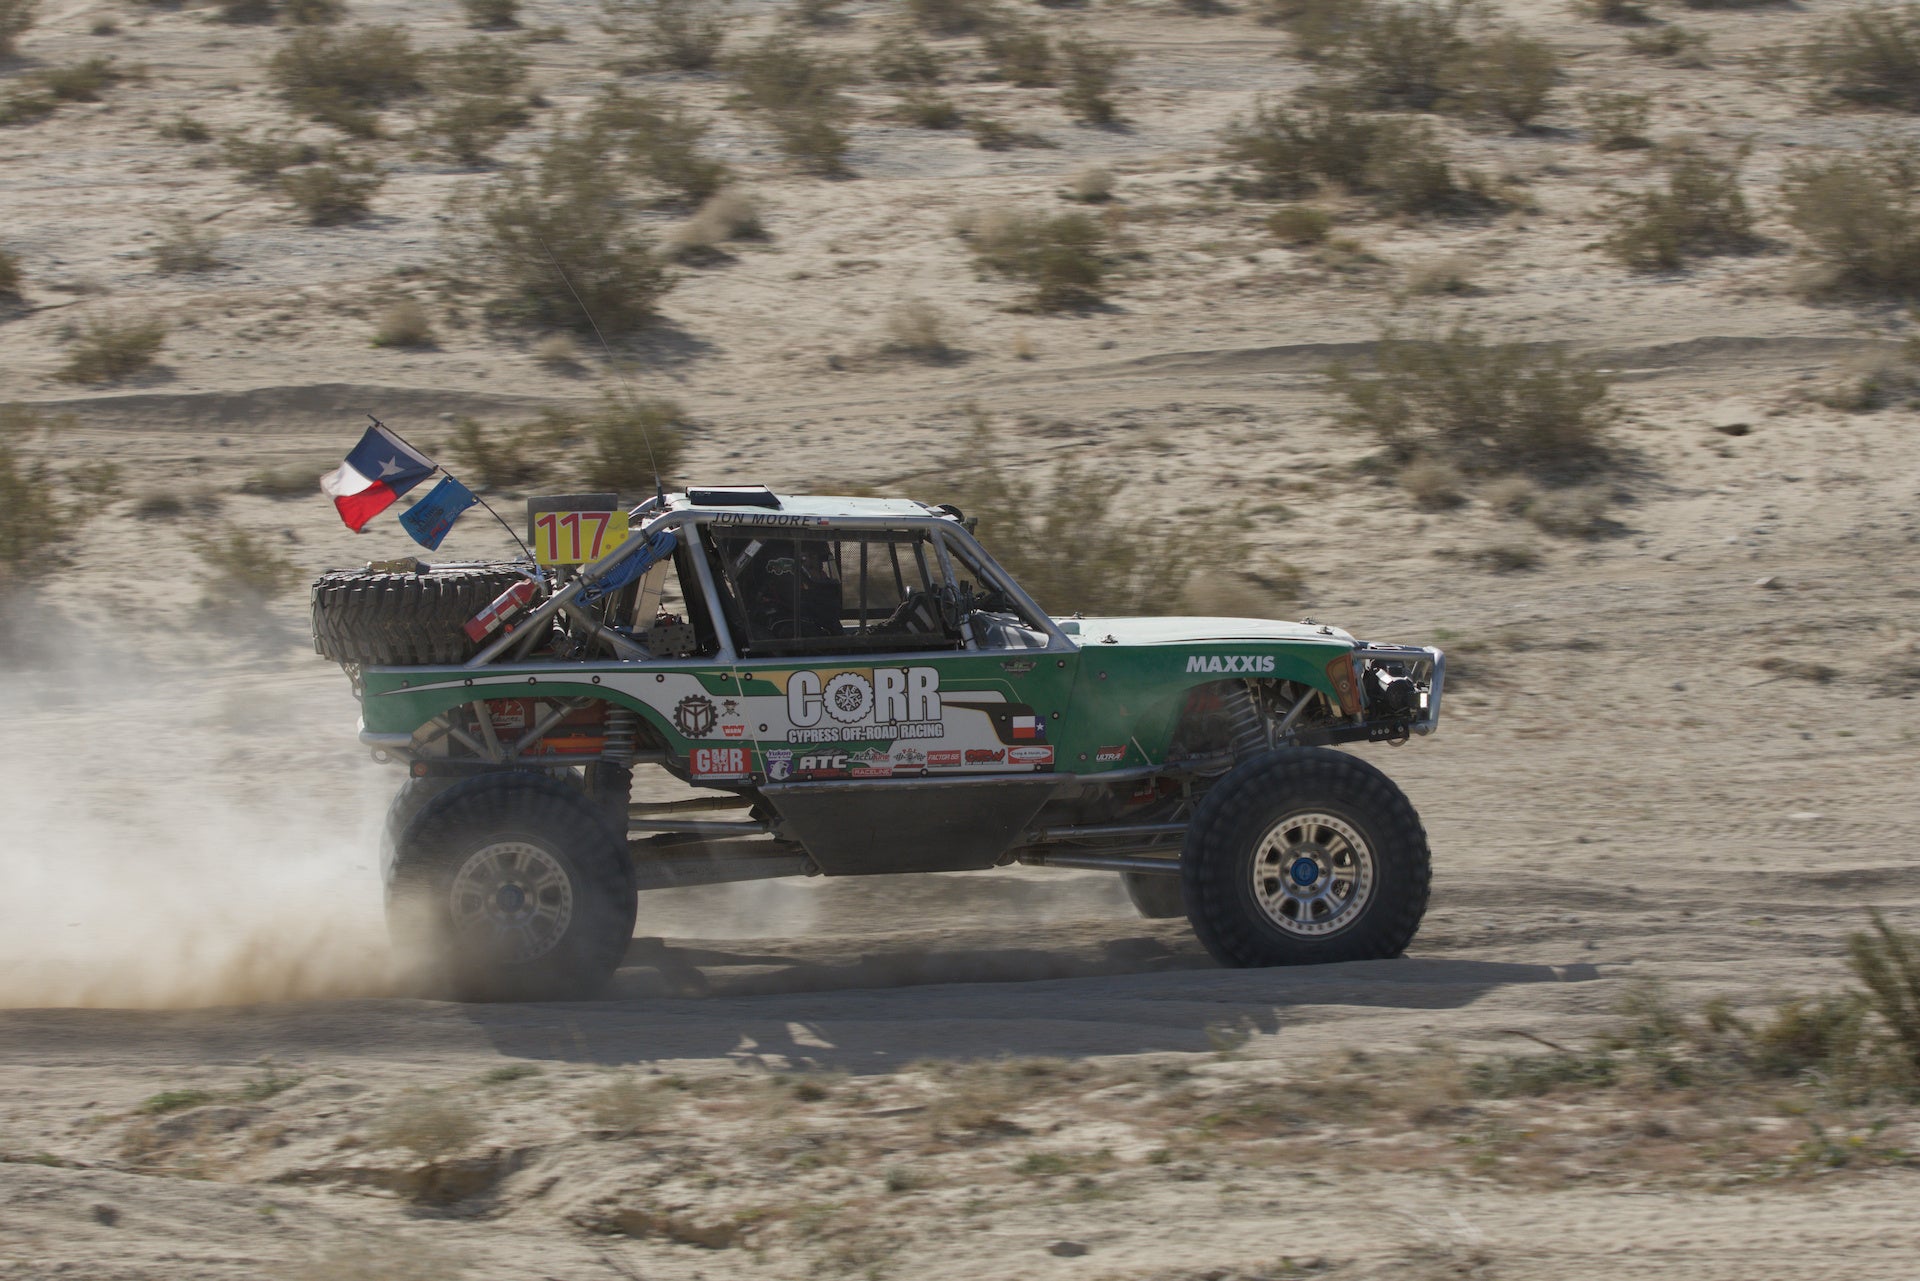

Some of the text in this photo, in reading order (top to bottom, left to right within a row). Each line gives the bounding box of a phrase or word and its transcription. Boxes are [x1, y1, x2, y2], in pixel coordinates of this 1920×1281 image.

[713, 512, 811, 527] JON MOORE
[536, 512, 611, 561] 117
[1186, 655, 1276, 673] MAXXIS
[787, 667, 942, 727] CORR
[787, 723, 944, 745] CYPRESS OFF-ROAD RACING
[800, 755, 848, 770] ATC
